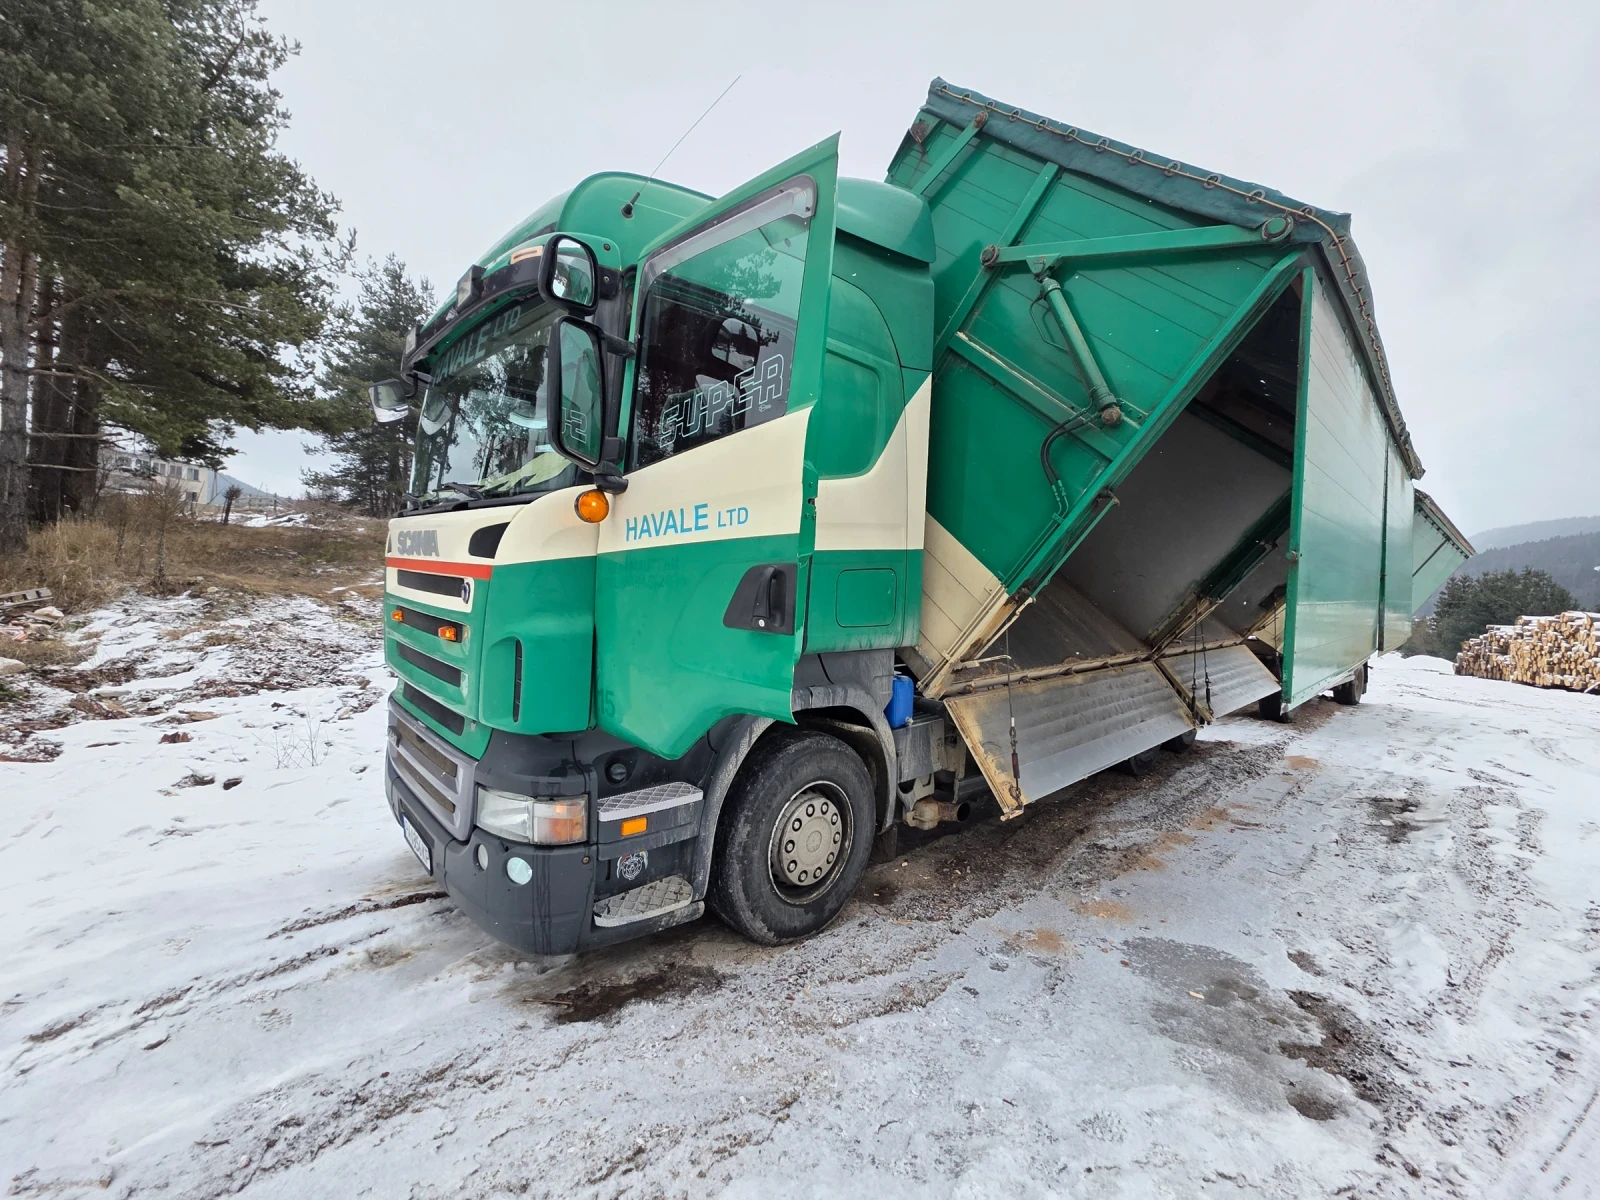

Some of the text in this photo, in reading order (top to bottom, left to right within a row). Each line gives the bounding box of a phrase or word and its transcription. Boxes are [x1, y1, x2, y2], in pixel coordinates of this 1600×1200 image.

[431, 305, 522, 388] HAVALE LTD
[659, 353, 785, 449] SUPER
[397, 529, 440, 557] SCANIA
[625, 503, 749, 542] HAVALE LTD
